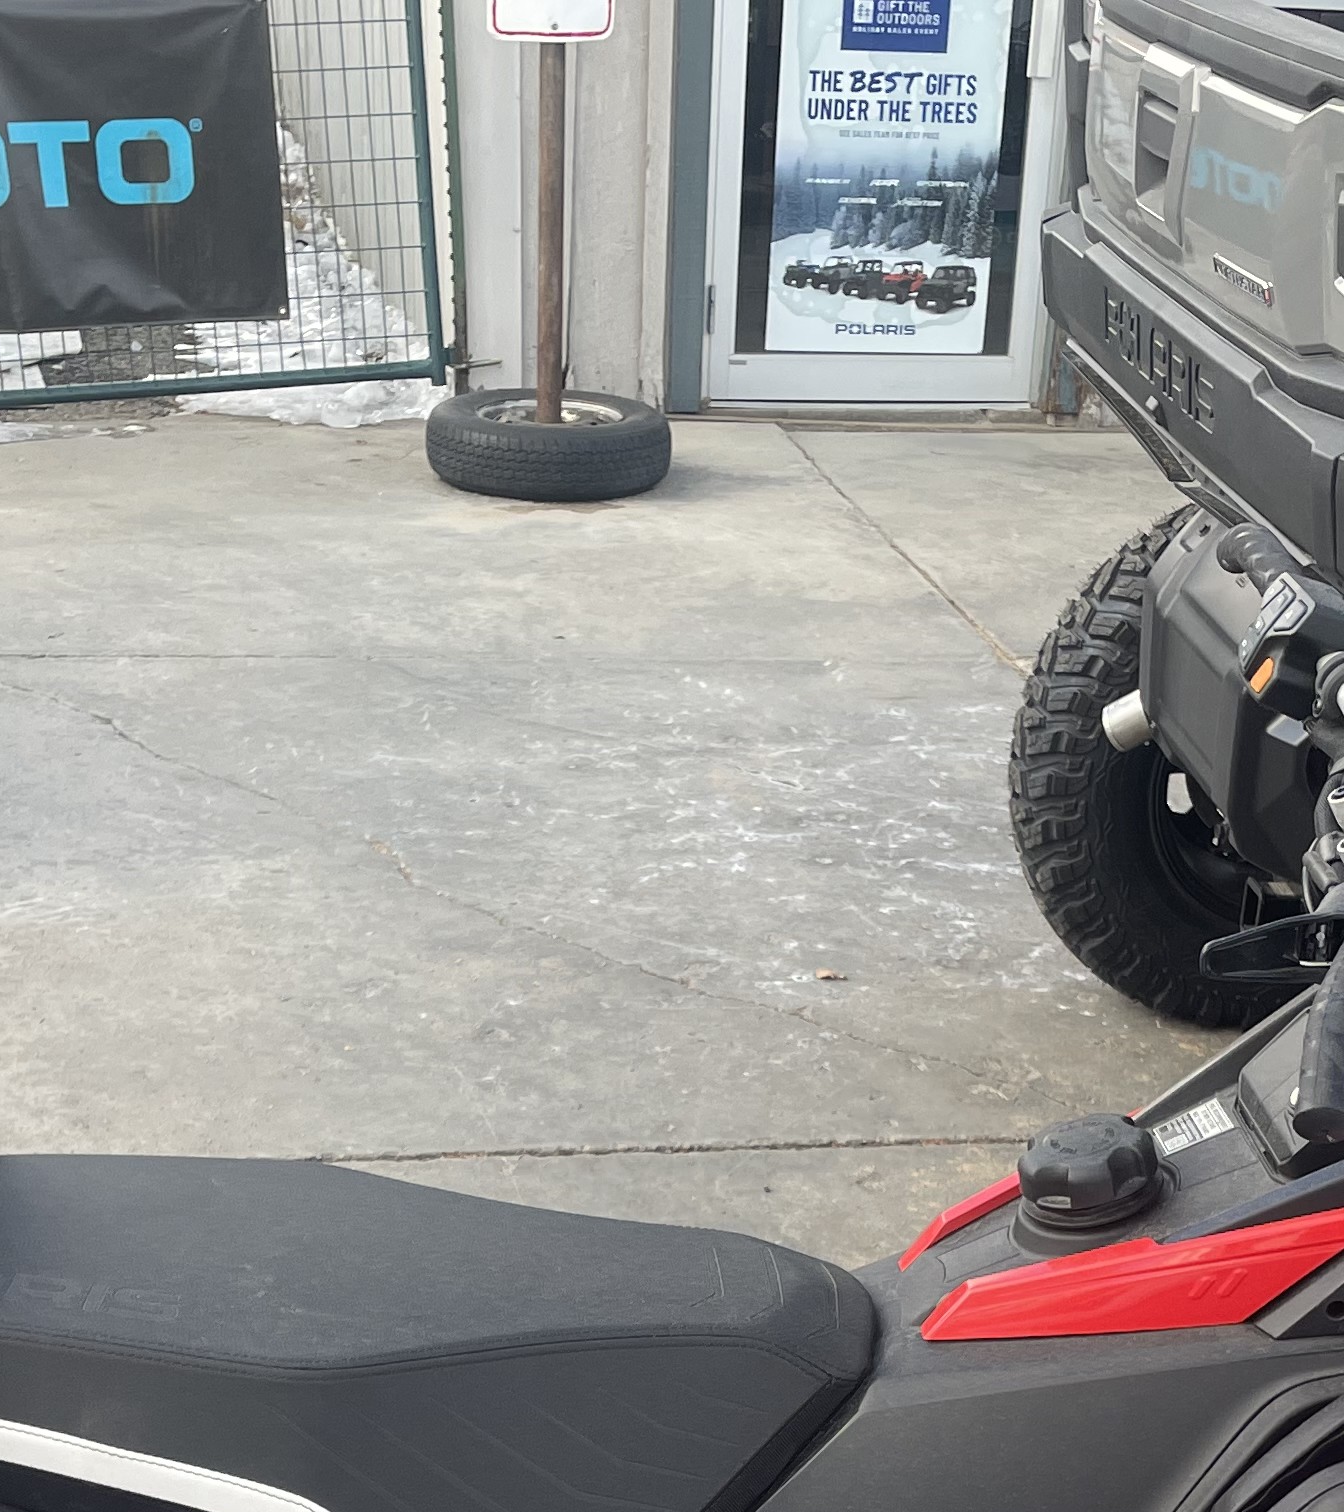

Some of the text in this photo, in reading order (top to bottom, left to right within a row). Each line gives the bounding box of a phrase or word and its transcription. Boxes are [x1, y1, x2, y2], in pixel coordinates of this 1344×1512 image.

[877, 0, 930, 13] GIFT THE
[876, 12, 941, 26] OUTDOORS
[809, 70, 977, 96] THE BEST GIFTS
[808, 98, 978, 124] UNDER THE TREES
[835, 324, 916, 335] POLARIS
[1104, 286, 1215, 435] POLARIS
